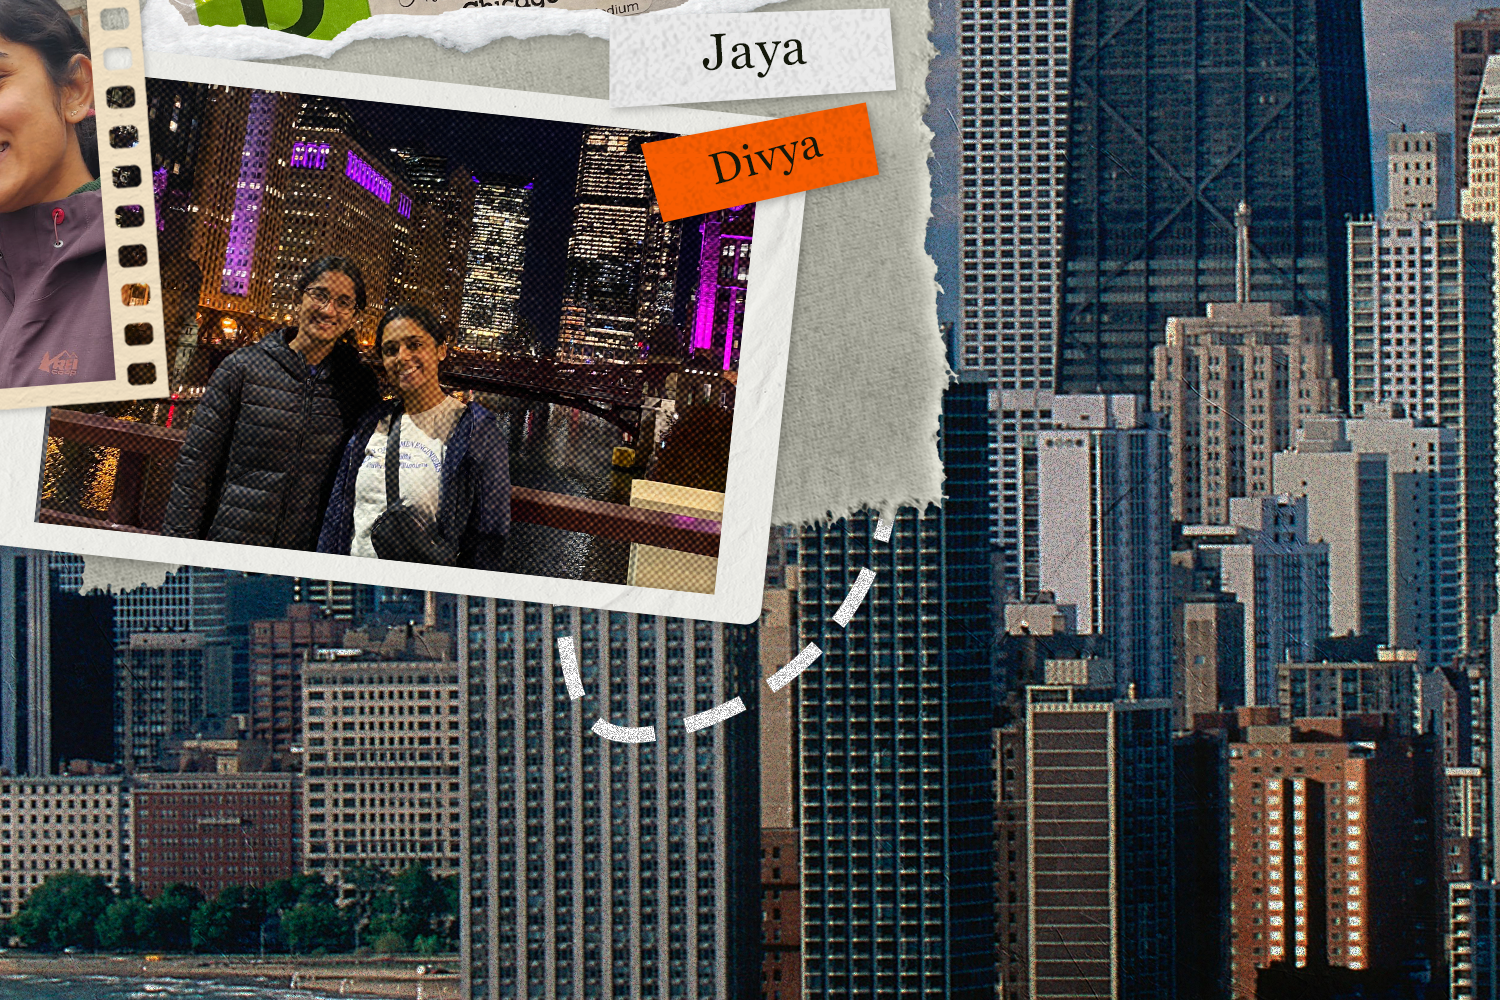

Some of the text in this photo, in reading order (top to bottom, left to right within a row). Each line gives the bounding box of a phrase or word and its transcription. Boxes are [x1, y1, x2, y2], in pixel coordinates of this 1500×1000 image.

[702, 33, 808, 79] Jaya
[708, 135, 824, 185] Divya
[52, 358, 79, 371] REI
